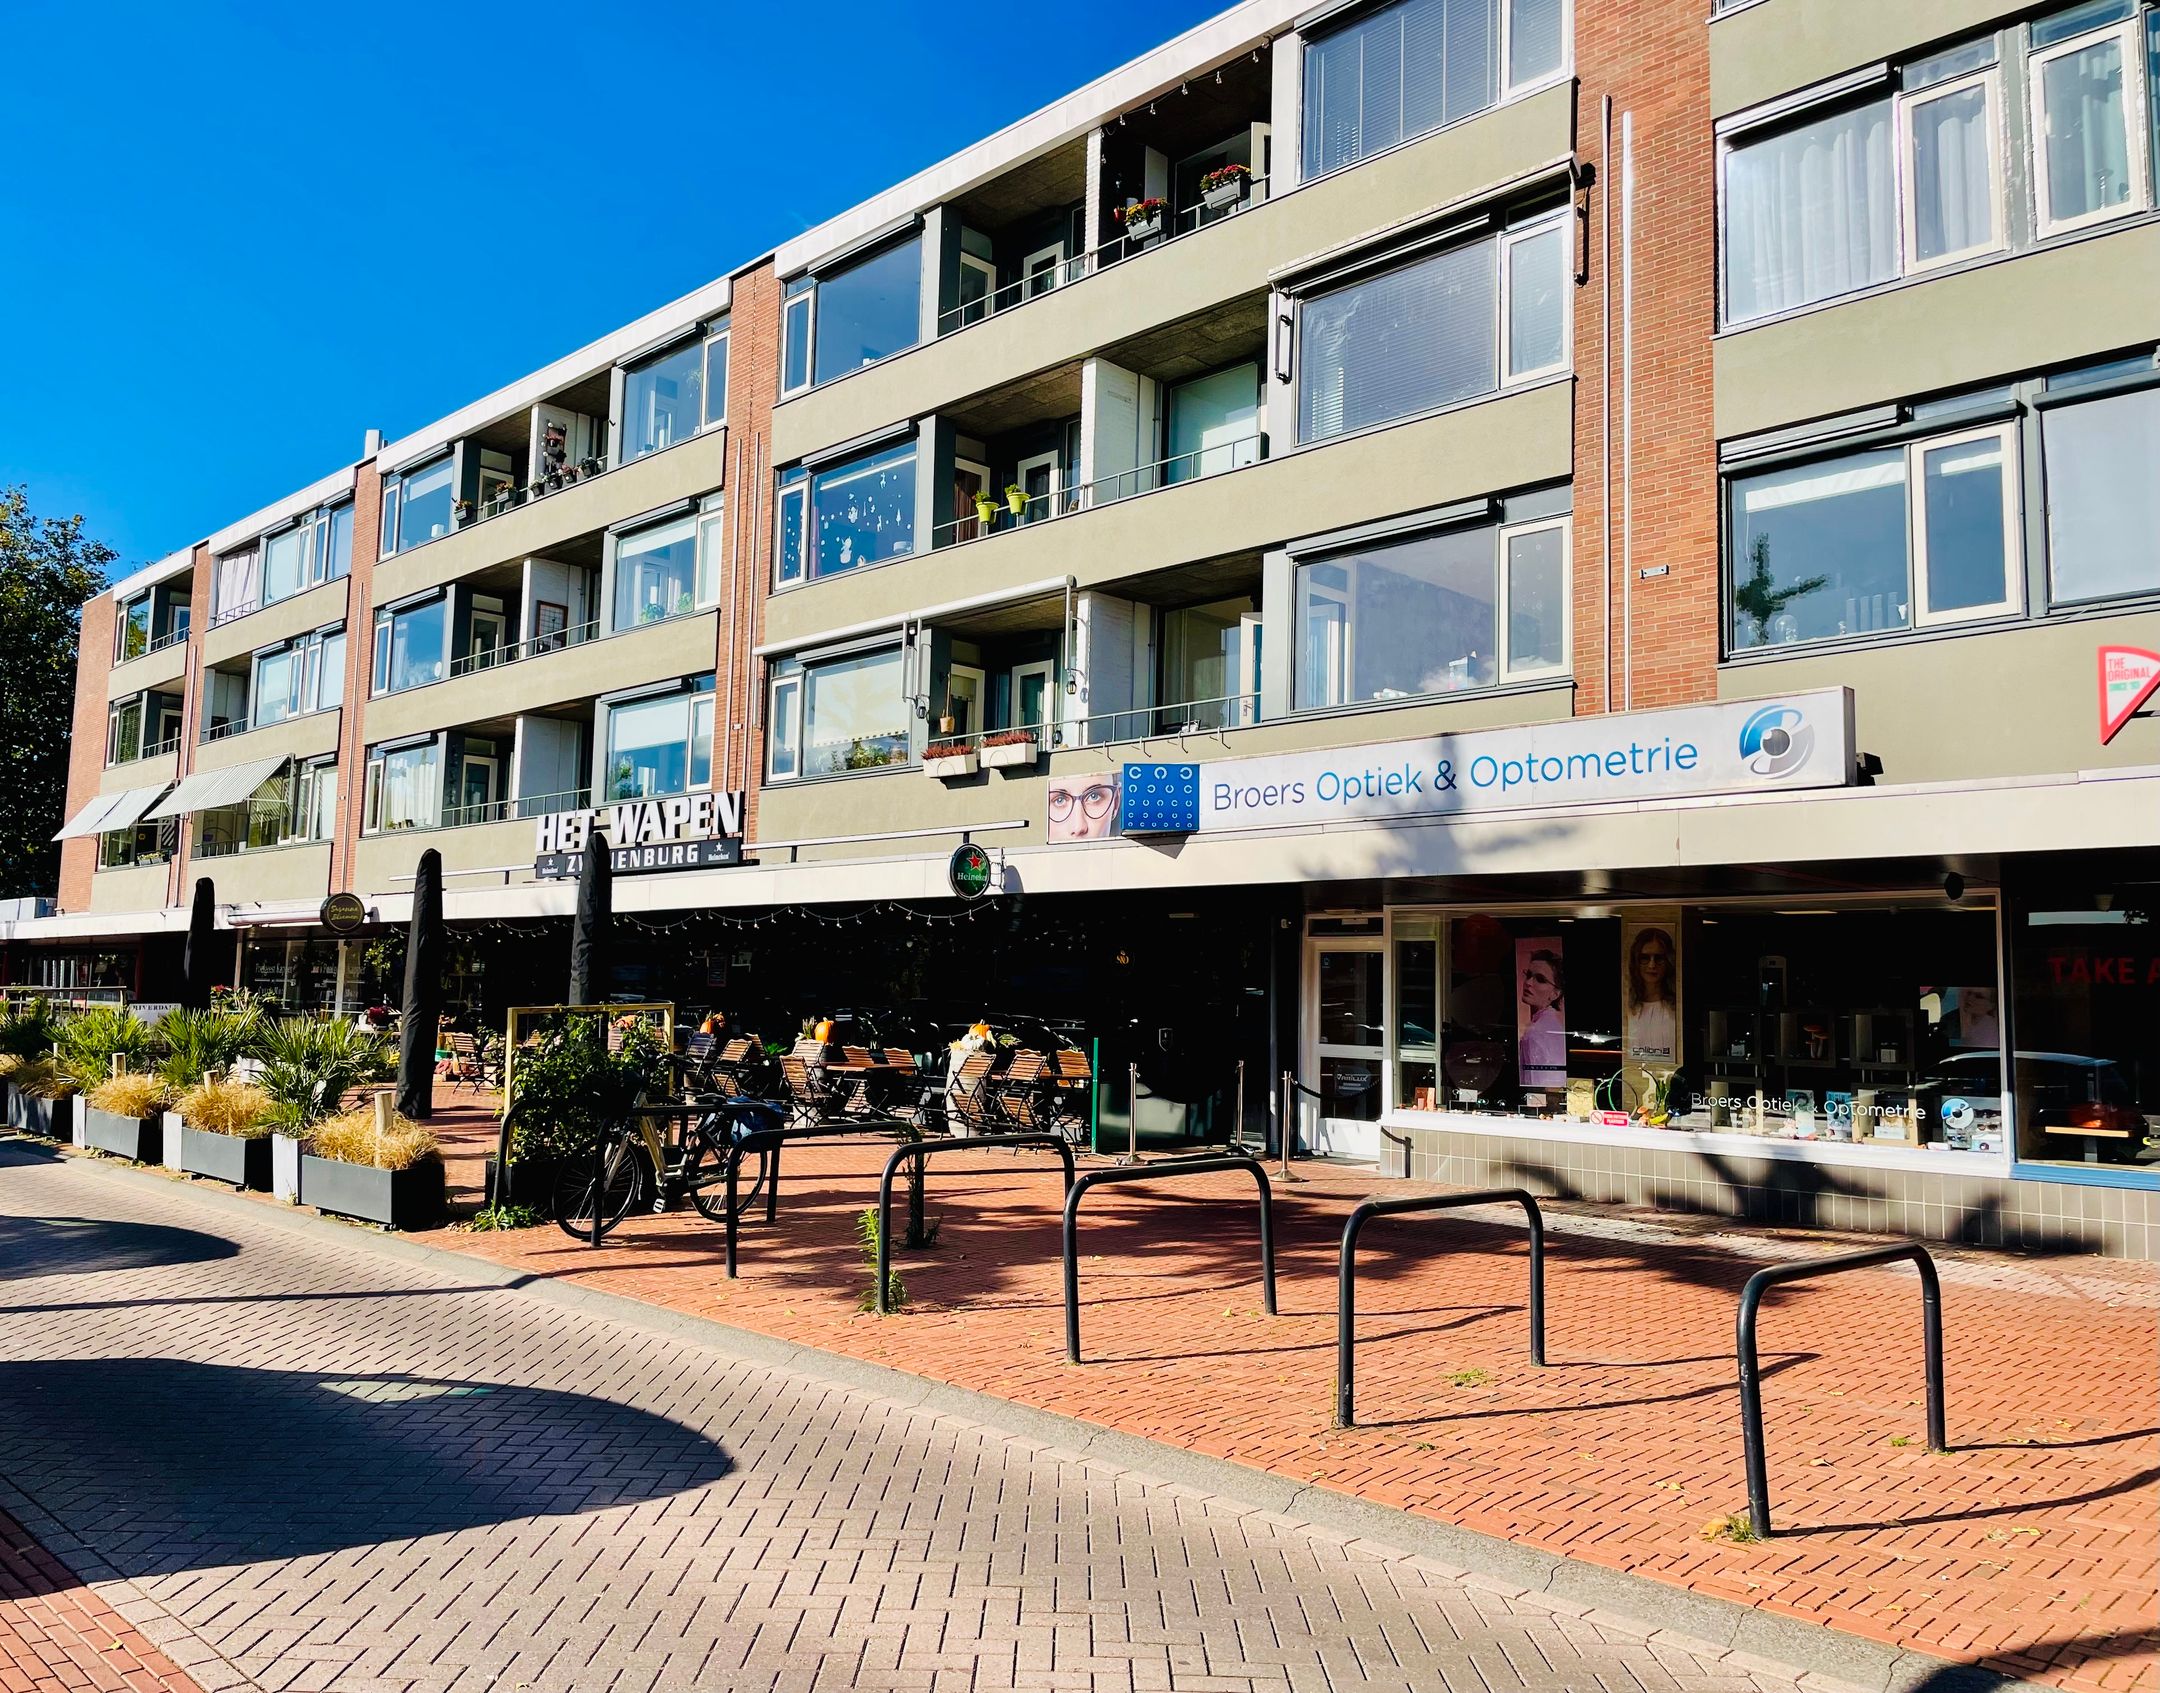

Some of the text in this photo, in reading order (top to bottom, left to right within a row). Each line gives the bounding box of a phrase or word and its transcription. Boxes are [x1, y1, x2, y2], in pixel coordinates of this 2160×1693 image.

[1214, 737, 1698, 811] Broers Optiek & Optometrie
[535, 790, 742, 852] HET WAPEN
[2048, 957, 2135, 985] TAKE
[1691, 1092, 1741, 1109] Broers
[1746, 1094, 1800, 1113] Optiek
